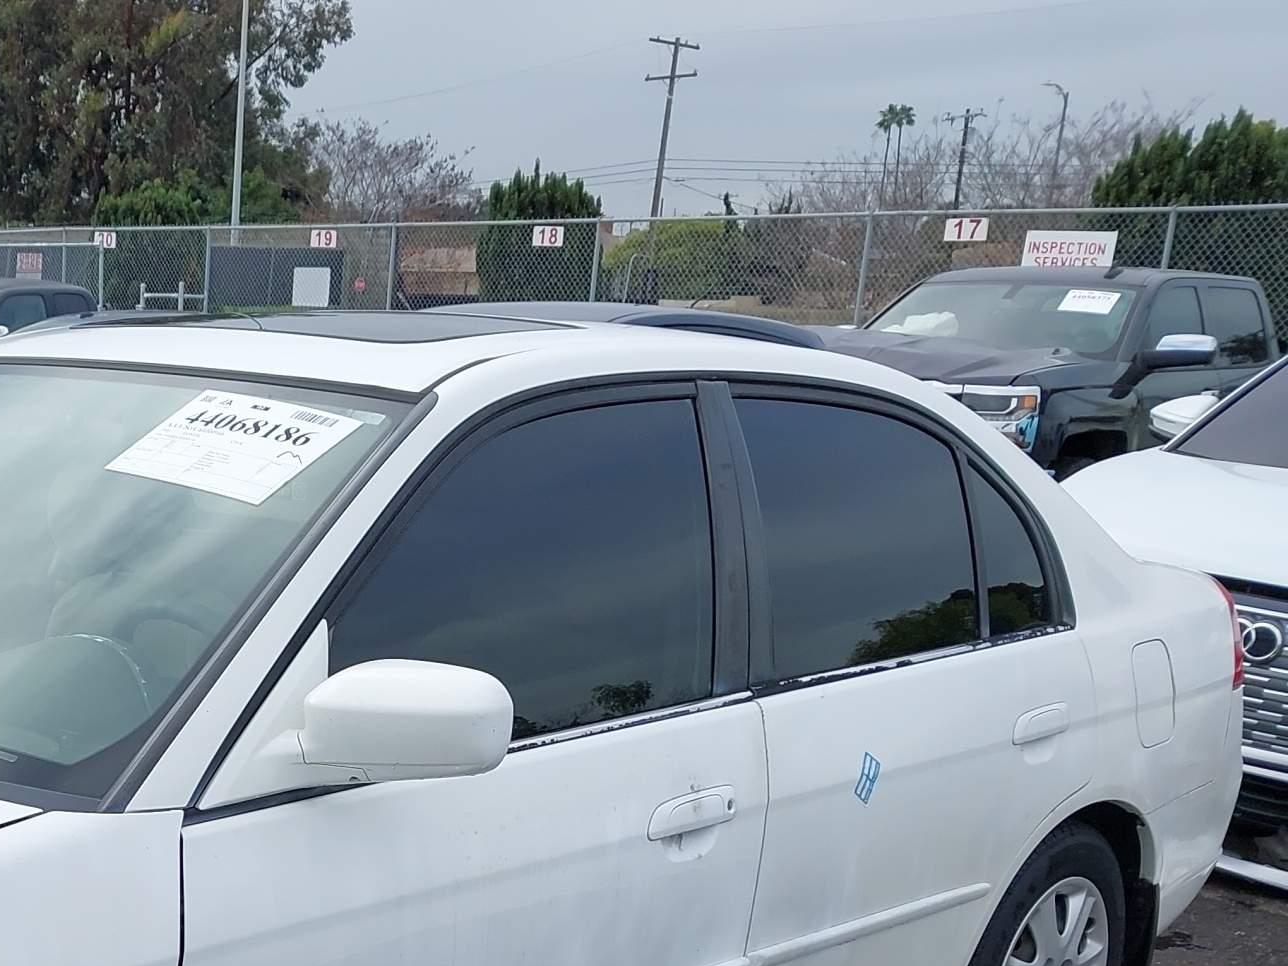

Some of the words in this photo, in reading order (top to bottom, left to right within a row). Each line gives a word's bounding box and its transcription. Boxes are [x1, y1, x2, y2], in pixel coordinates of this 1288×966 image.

[539, 227, 557, 245] 18
[954, 219, 982, 240] 17
[315, 231, 332, 246] 19
[1027, 240, 1107, 256] INSPECTION
[1034, 256, 1098, 267] SERVICES
[185, 410, 320, 447] 44068186
